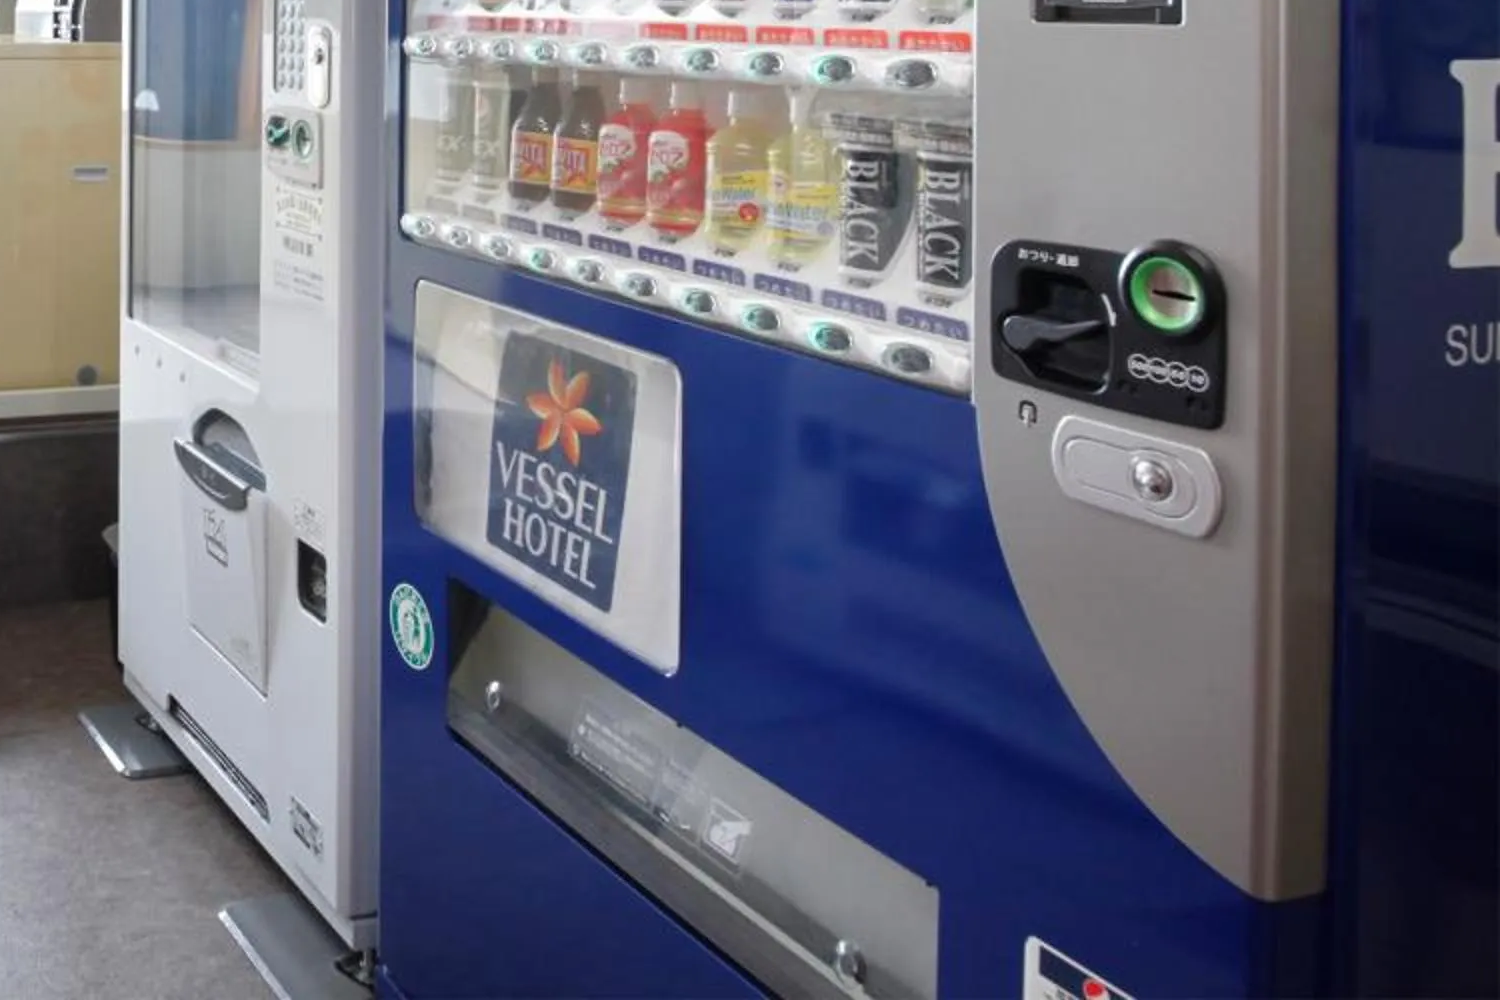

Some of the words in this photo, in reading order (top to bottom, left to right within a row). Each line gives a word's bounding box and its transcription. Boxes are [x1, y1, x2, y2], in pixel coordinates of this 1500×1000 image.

[847, 160, 880, 265] BLACK
[923, 170, 960, 282] BLACK
[497, 440, 614, 545] VESSEL
[503, 497, 597, 590] HOTEL
